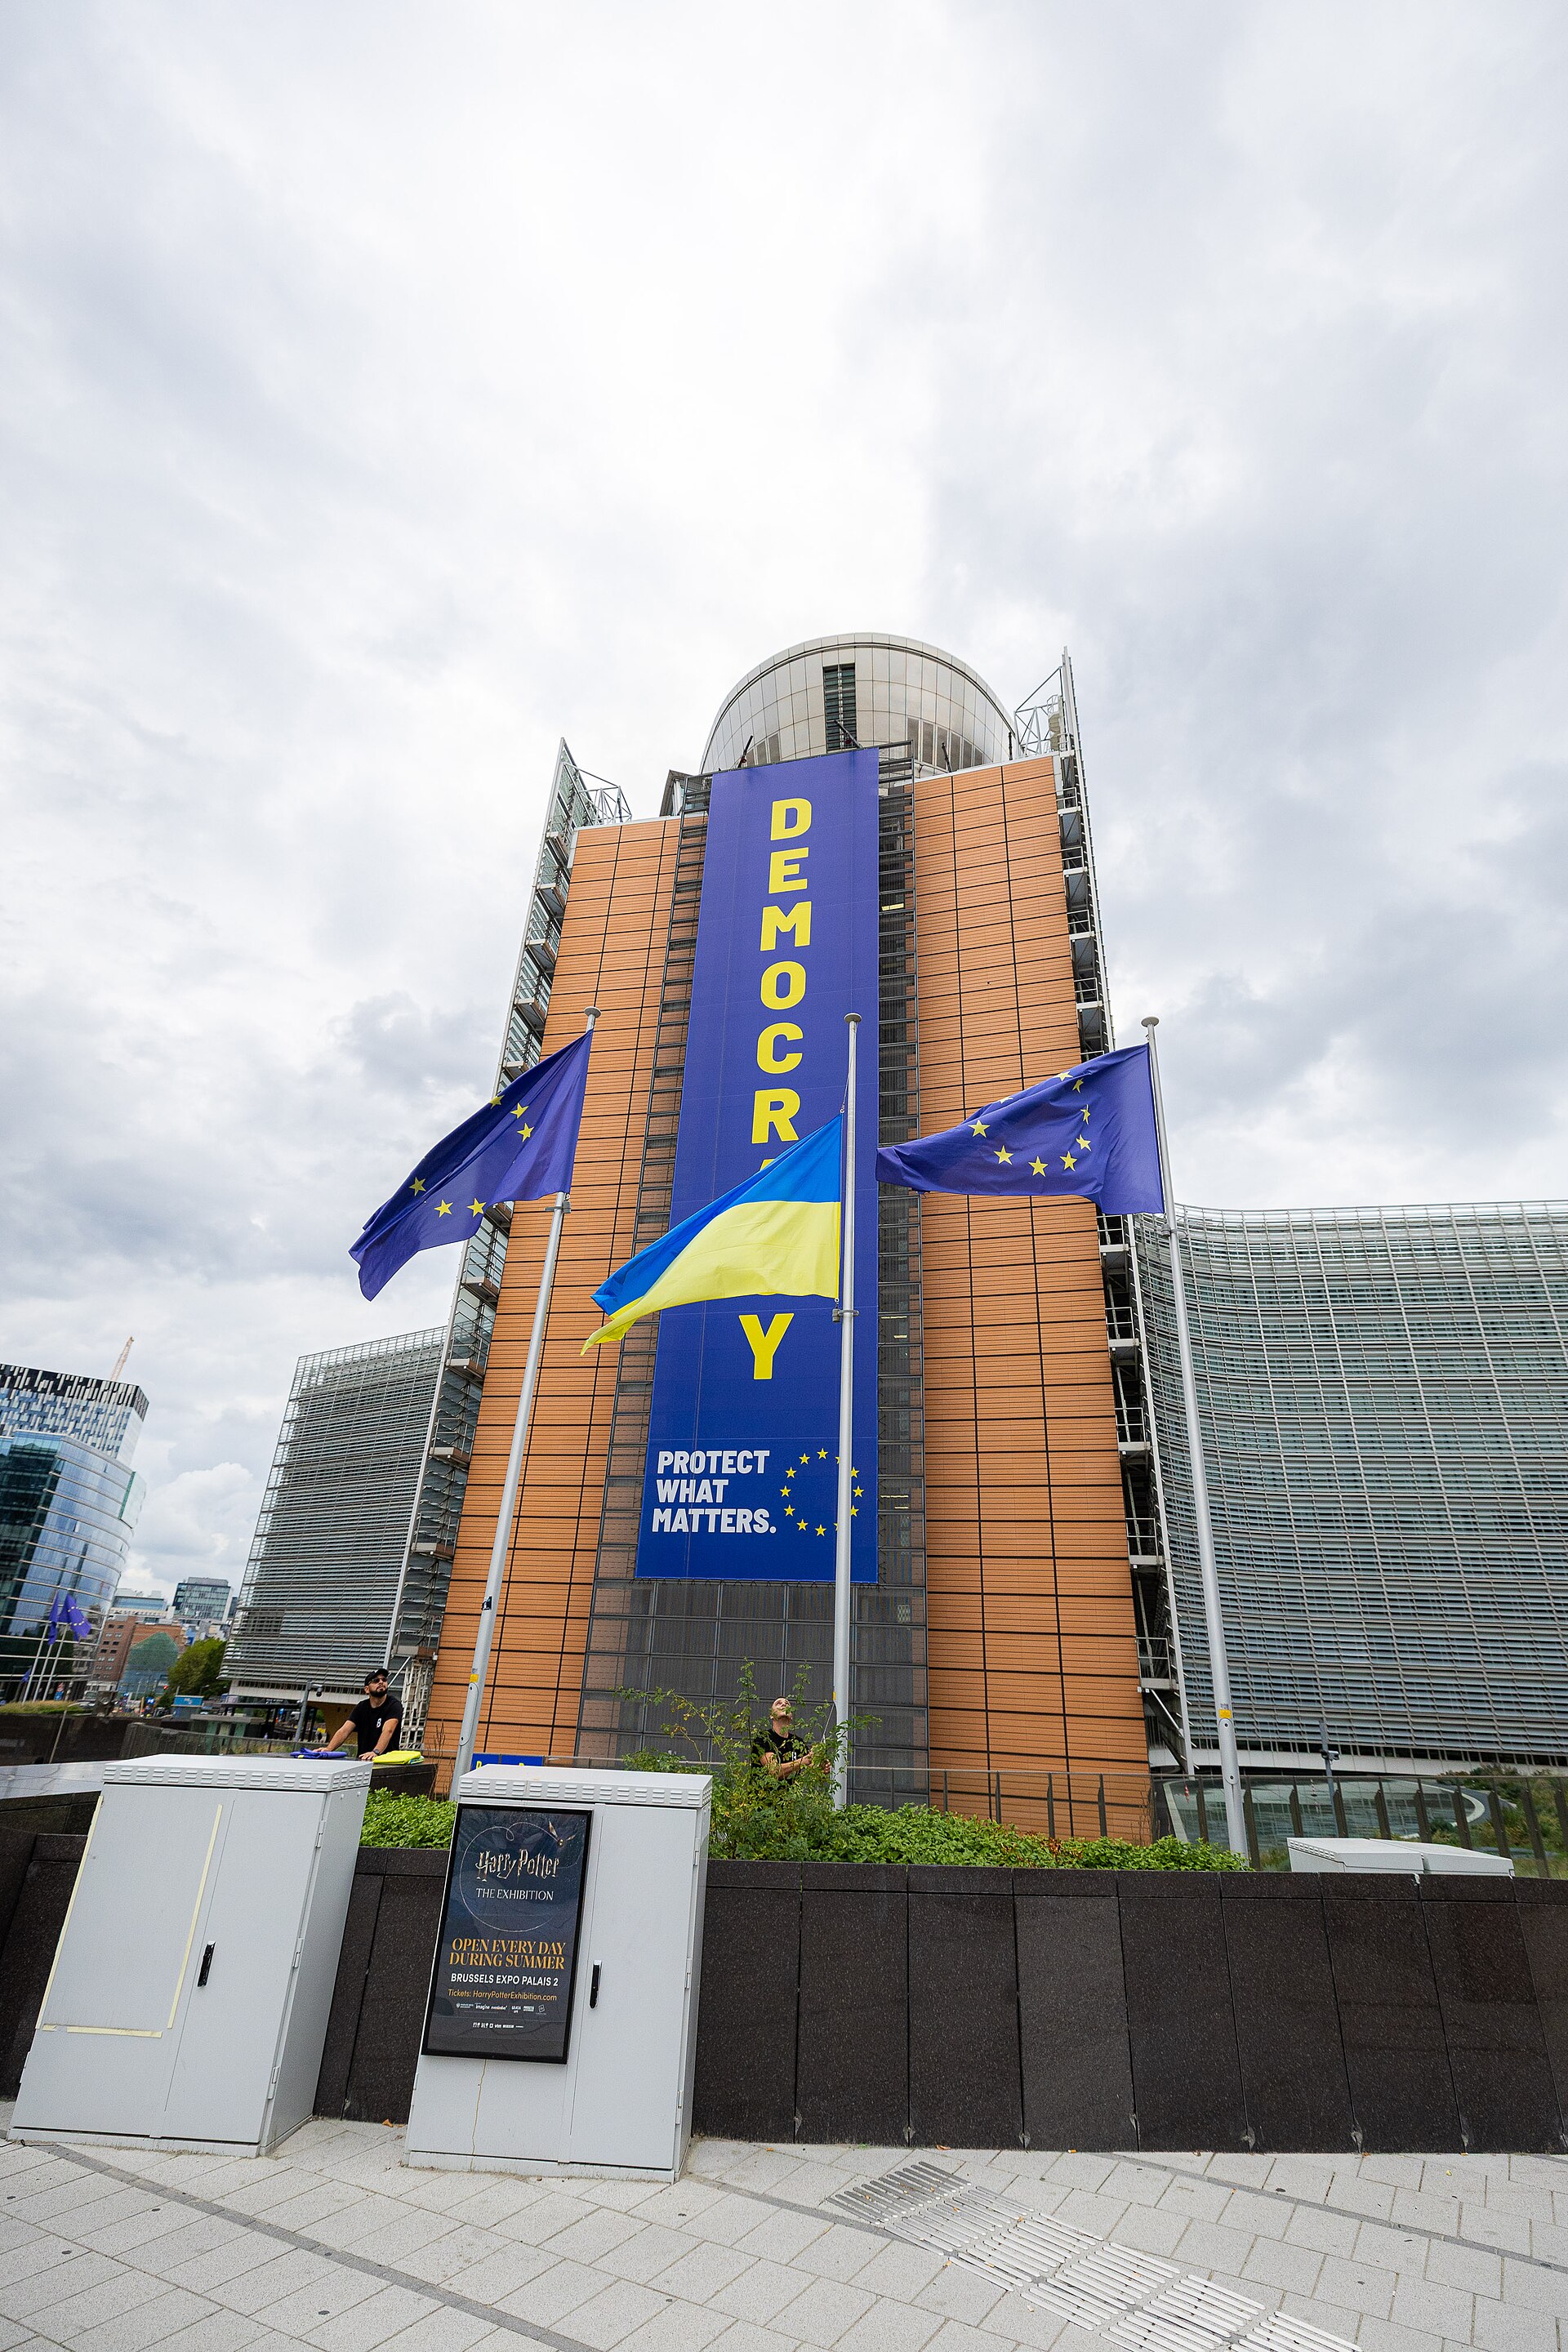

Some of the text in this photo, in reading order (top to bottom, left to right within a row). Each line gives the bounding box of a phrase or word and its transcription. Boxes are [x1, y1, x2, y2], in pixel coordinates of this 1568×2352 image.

[739, 797, 812, 1380] DEMOCRY
[657, 1450, 770, 1474] PROTECT
[656, 1479, 729, 1503] WHAT
[652, 1508, 777, 1534] MATTERS.
[474, 1848, 560, 1882] Harry Potter
[475, 1887, 555, 1901] THE EXHIBITION
[452, 1937, 566, 1955] OPEN EVERY DAY
[449, 1952, 565, 1970] DURING SUMMER
[451, 1972, 559, 1987] BRUSSELS EXPO PALAIS 2
[448, 1989, 557, 2002] Tickets: HarryPotterExhibition.com
